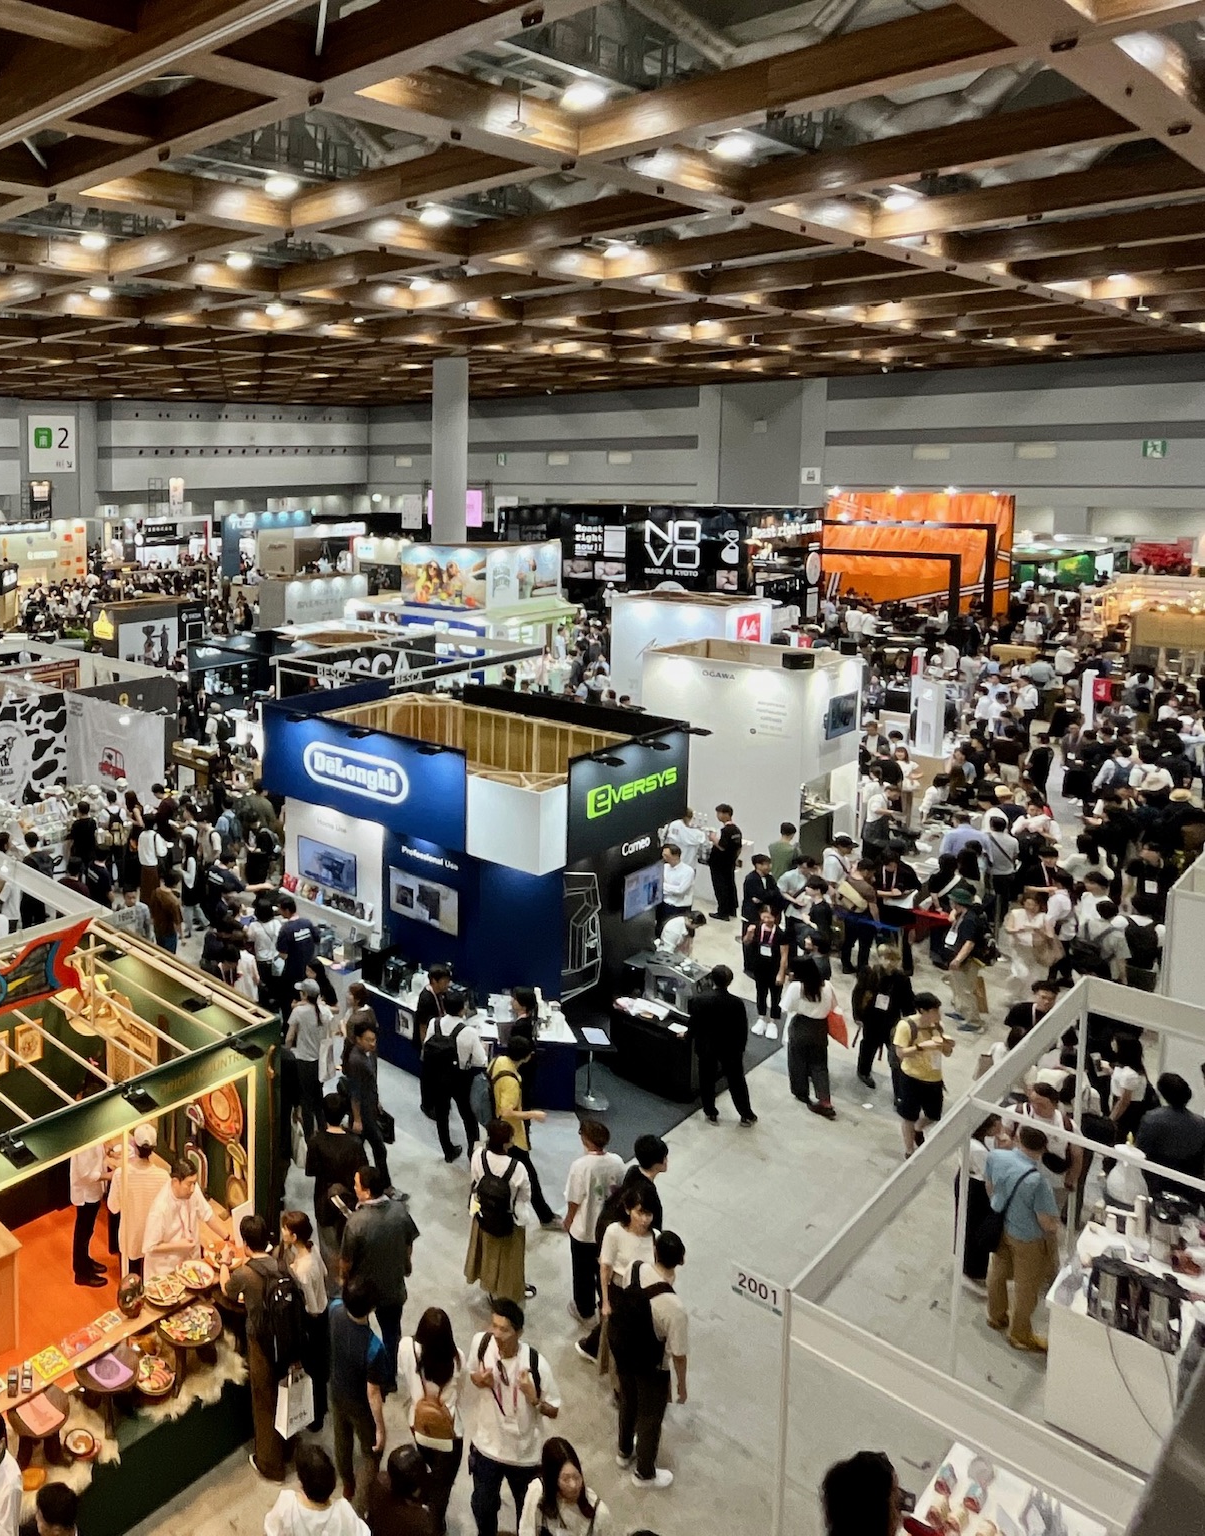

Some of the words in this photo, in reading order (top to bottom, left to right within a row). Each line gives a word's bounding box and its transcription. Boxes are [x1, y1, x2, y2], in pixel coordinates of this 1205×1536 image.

[57, 427, 69, 449] 2
[575, 523, 603, 533] Roast
[575, 533, 603, 543] right
[644, 519, 701, 545] NO
[777, 521, 801, 540] right
[644, 543, 700, 569] VO
[317, 665, 351, 681] BESCA
[395, 671, 424, 685] BESCA
[702, 669, 736, 680] OGAWA
[622, 836, 651, 857] Cameo
[401, 845, 444, 867] Professional
[444, 859, 459, 872] Use
[738, 1272, 777, 1305] 2001
